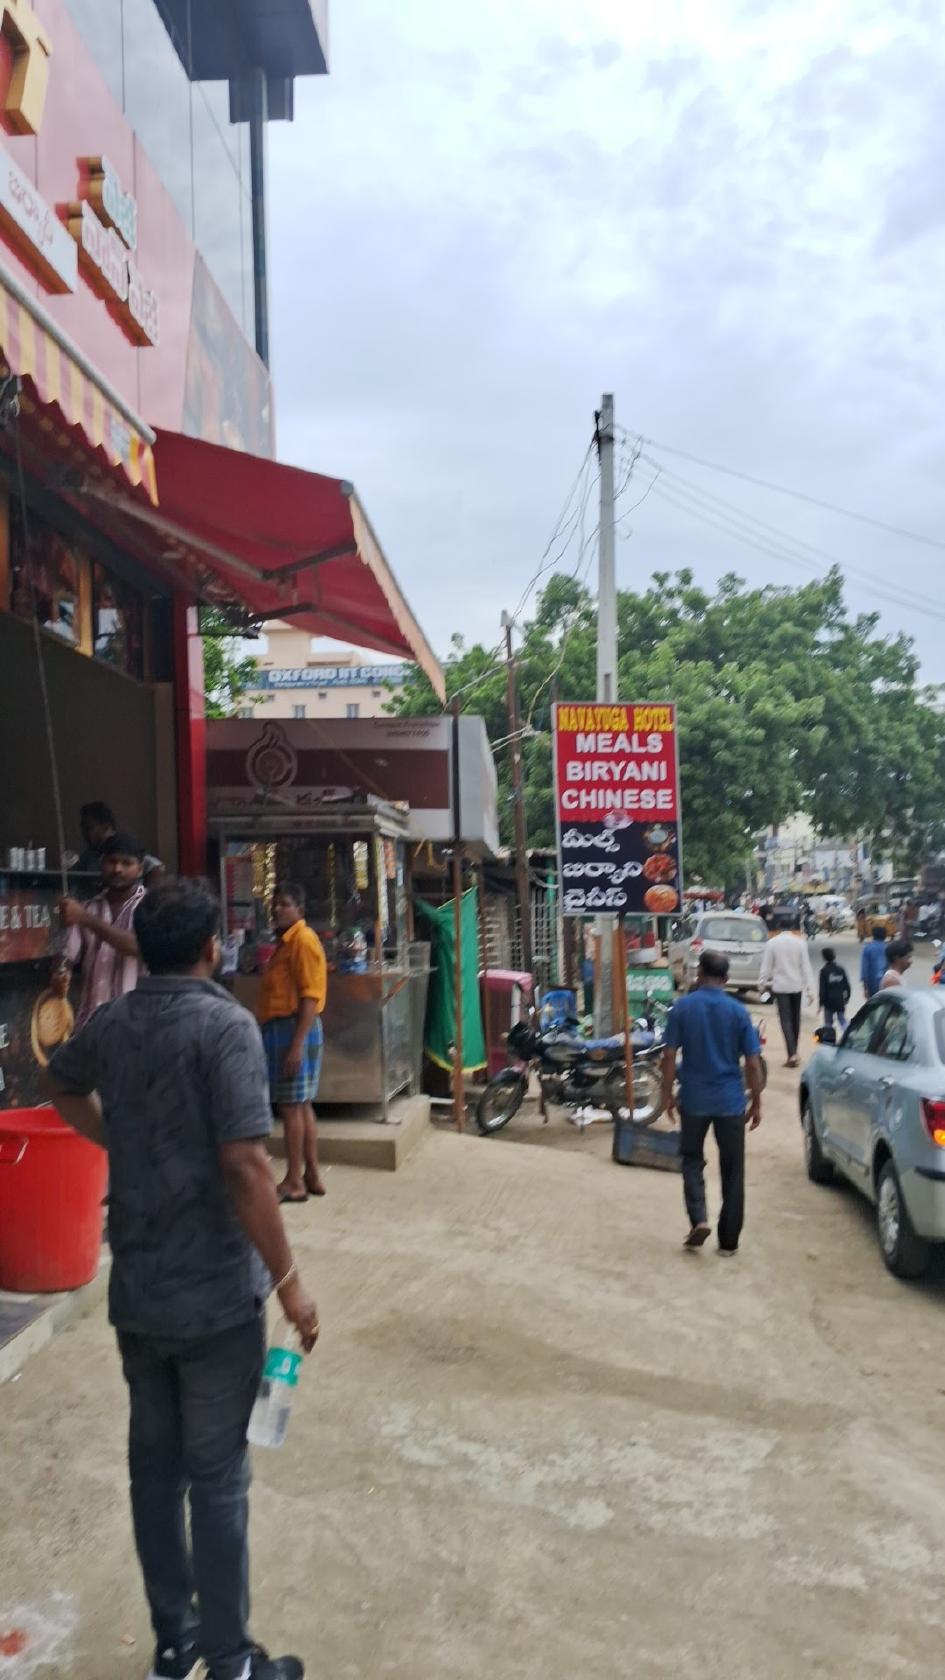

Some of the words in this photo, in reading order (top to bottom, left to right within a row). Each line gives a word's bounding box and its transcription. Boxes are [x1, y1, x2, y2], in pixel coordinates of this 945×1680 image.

[558, 706, 630, 732] NAVAYUGA
[633, 706, 674, 732] HOTEL
[576, 732, 663, 754] MEALS
[566, 760, 667, 782] BIRYANI
[561, 788, 674, 810] CHINESE
[24, 904, 51, 929] TEA
